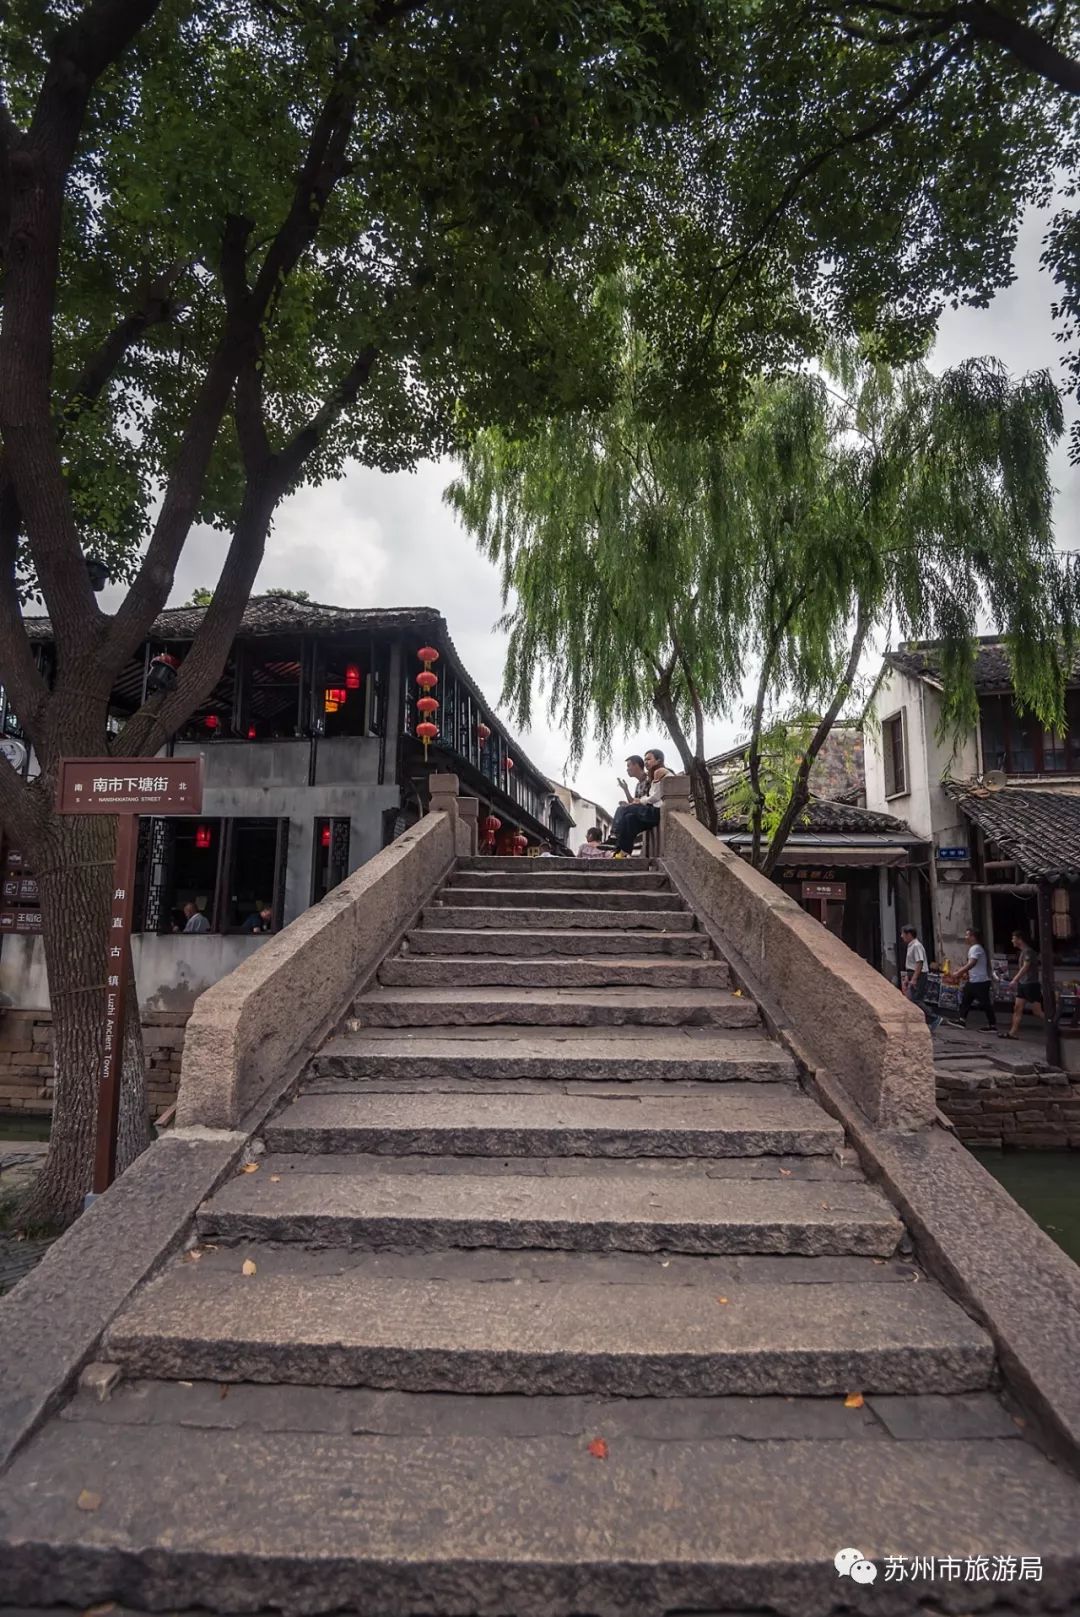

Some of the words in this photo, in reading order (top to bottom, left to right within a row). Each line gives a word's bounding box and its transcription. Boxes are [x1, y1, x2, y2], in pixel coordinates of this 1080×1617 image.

[74, 783, 83, 792] 南
[93, 776, 169, 792] 南市下塘街
[179, 782, 187, 791] 北
[107, 993, 116, 1016] Luzhi
[104, 1019, 114, 1050] Ancient
[103, 1055, 112, 1078] Town
